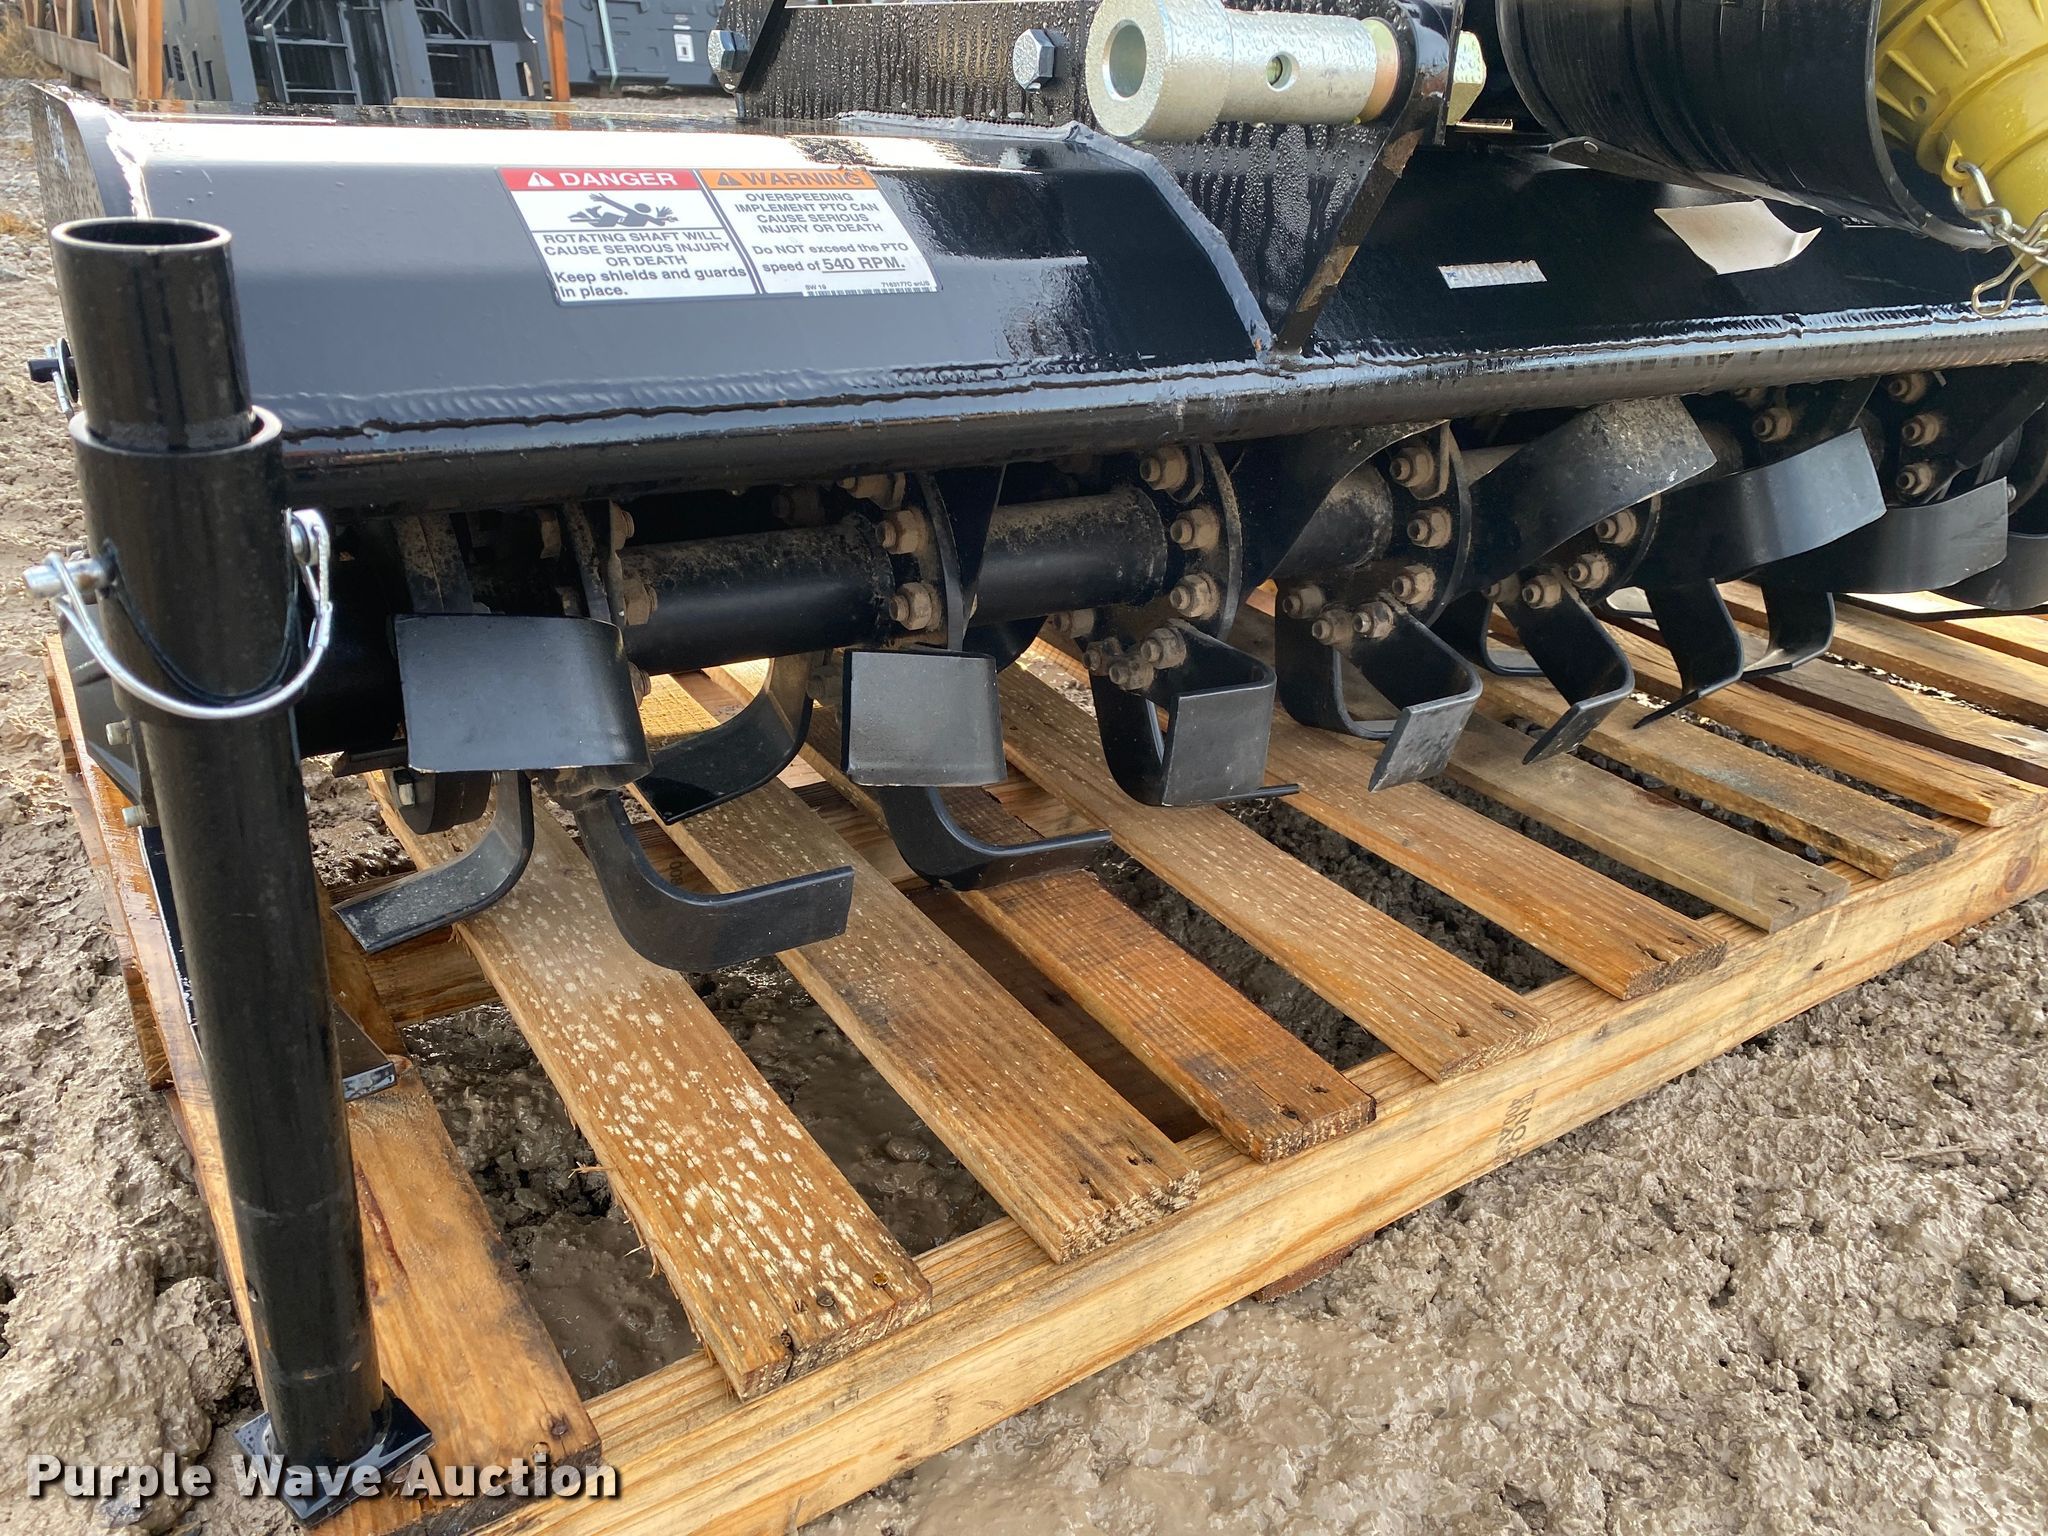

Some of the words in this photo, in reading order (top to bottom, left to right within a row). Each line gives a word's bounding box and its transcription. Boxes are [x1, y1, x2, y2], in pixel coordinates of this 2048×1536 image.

[559, 172, 678, 187] DANGER
[742, 172, 864, 186] WARNING
[745, 193, 854, 201] OVERSPEEDING
[735, 204, 816, 213] IMPLEMENT
[820, 203, 847, 212] PTO
[850, 203, 880, 211] CAN
[757, 214, 807, 223] CAUSE
[808, 214, 869, 222] SERIOUS
[758, 224, 808, 234] INJURY
[813, 224, 840, 233] OR
[842, 223, 883, 232] DEATH
[543, 233, 626, 243] ROTATING
[629, 232, 679, 242] SHAFT
[683, 231, 721, 241] WILL
[544, 245, 601, 256] CAUSE
[605, 244, 675, 255] SERIOUS
[676, 242, 730, 253] INJURY
[752, 246, 773, 255] Do
[776, 245, 804, 254] NOT
[809, 244, 856, 253] exceed
[858, 243, 879, 252] the
[881, 243, 909, 251] PTO
[606, 257, 631, 267] OR
[634, 255, 688, 266] DEATH
[763, 262, 804, 273] speed
[807, 260, 820, 271] of
[824, 258, 855, 271] 540
[859, 257, 905, 269] RPM.
[554, 272, 597, 284] Keep
[601, 269, 657, 282] shields
[661, 268, 690, 279] and
[694, 267, 747, 280] guards
[560, 286, 576, 298] in
[581, 285, 628, 299] place.
